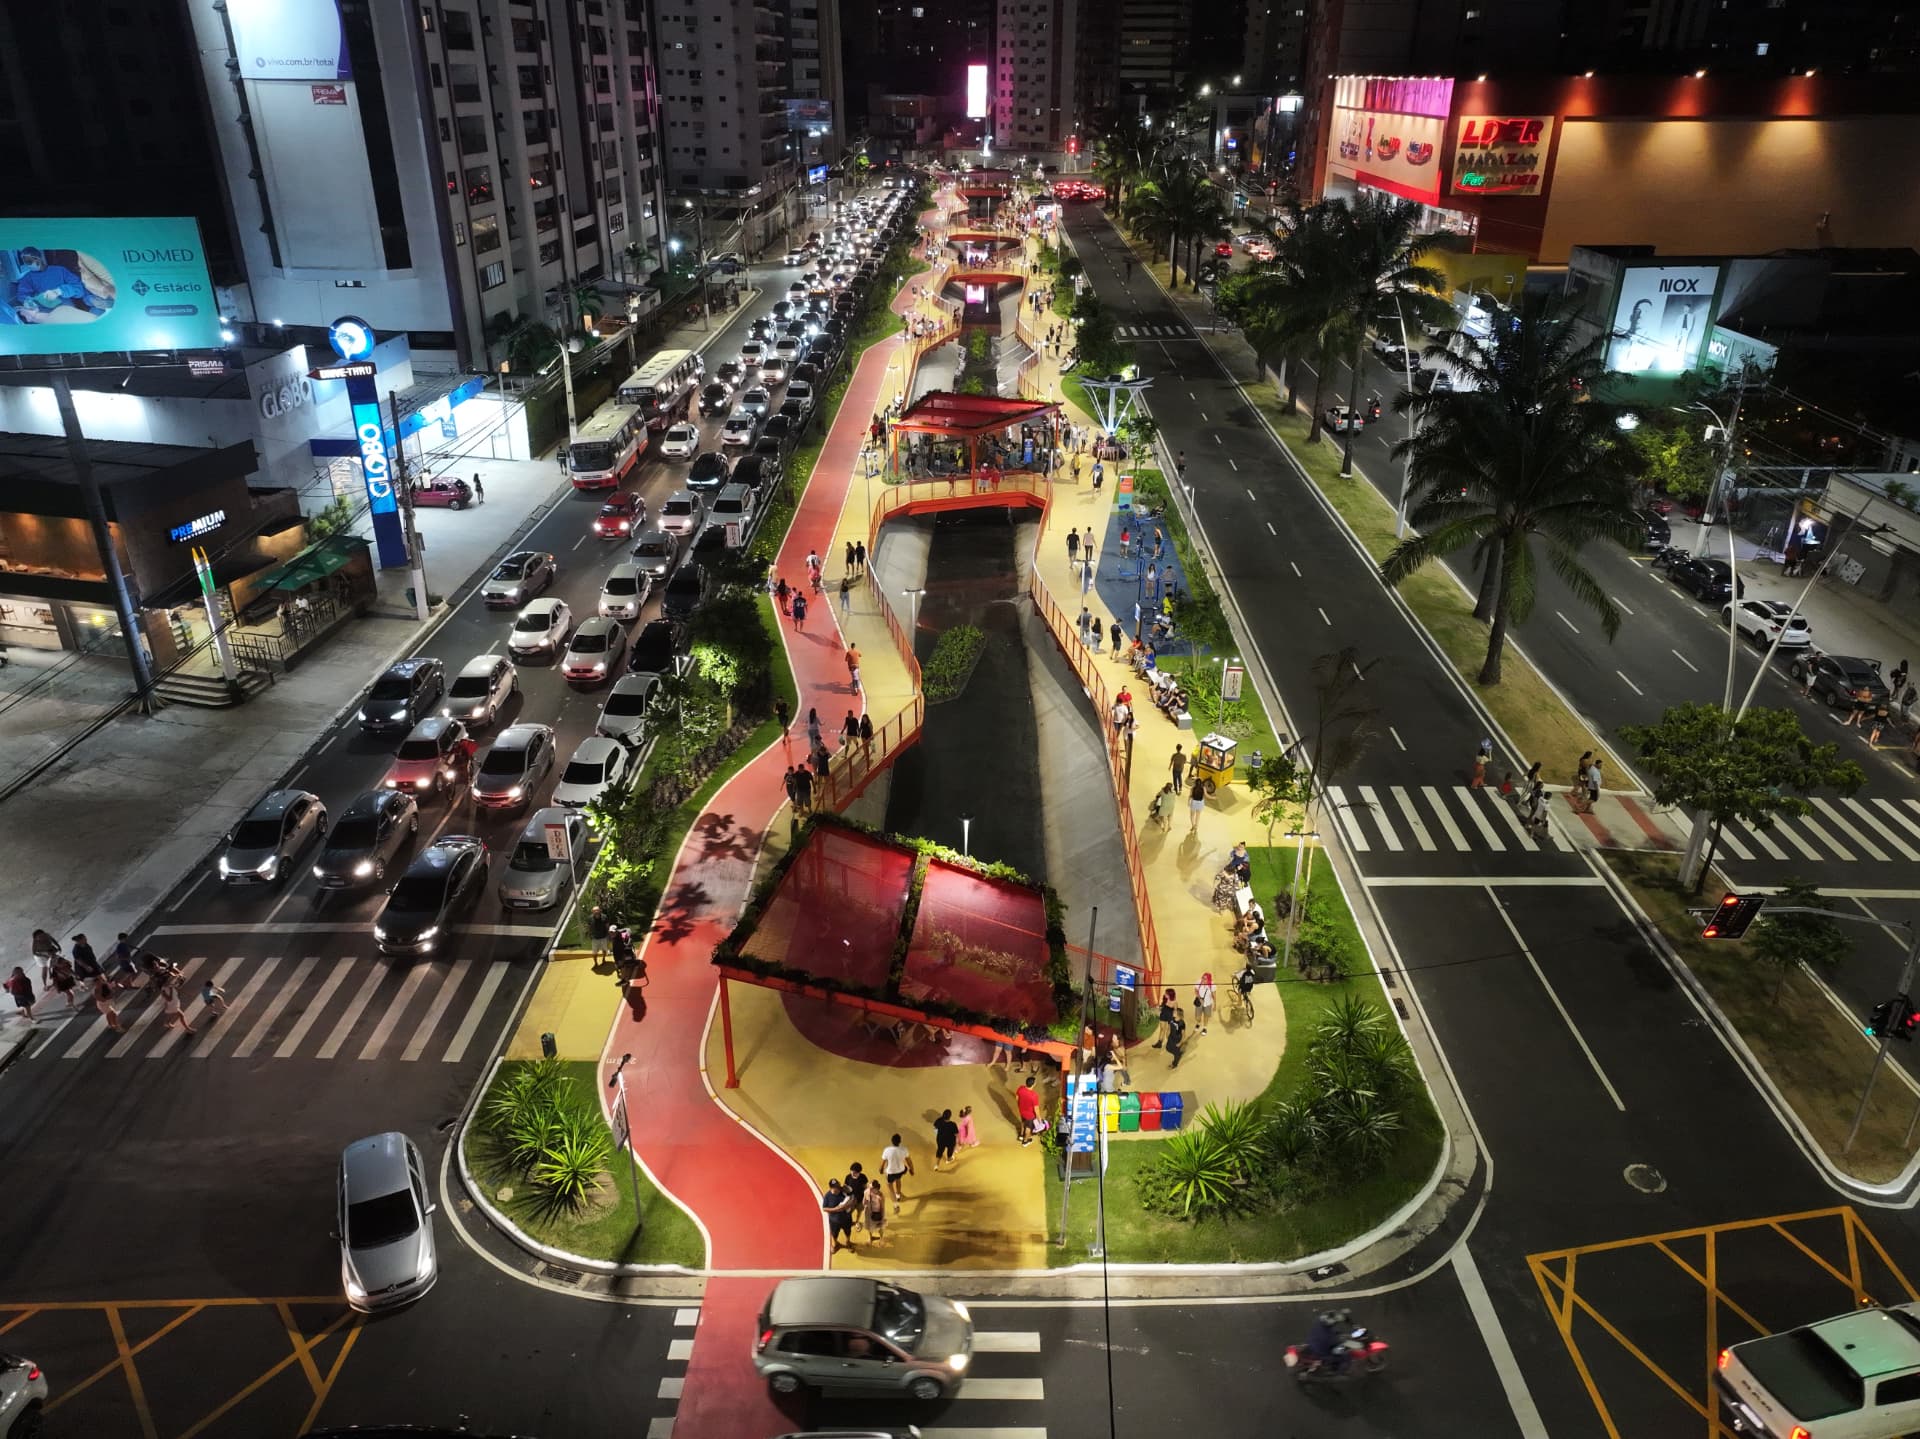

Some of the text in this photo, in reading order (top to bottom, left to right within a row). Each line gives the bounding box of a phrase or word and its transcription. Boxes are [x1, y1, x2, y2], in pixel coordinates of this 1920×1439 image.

[122, 249, 194, 263] IDOMED
[153, 281, 202, 293] Estácio
[1659, 279, 1700, 293] NOX
[1709, 340, 1728, 358] NOX
[188, 360, 225, 369] PRISMA
[260, 379, 312, 419] GLOBO
[358, 423, 391, 497] GLOBO
[170, 509, 226, 541] PREMIUM
